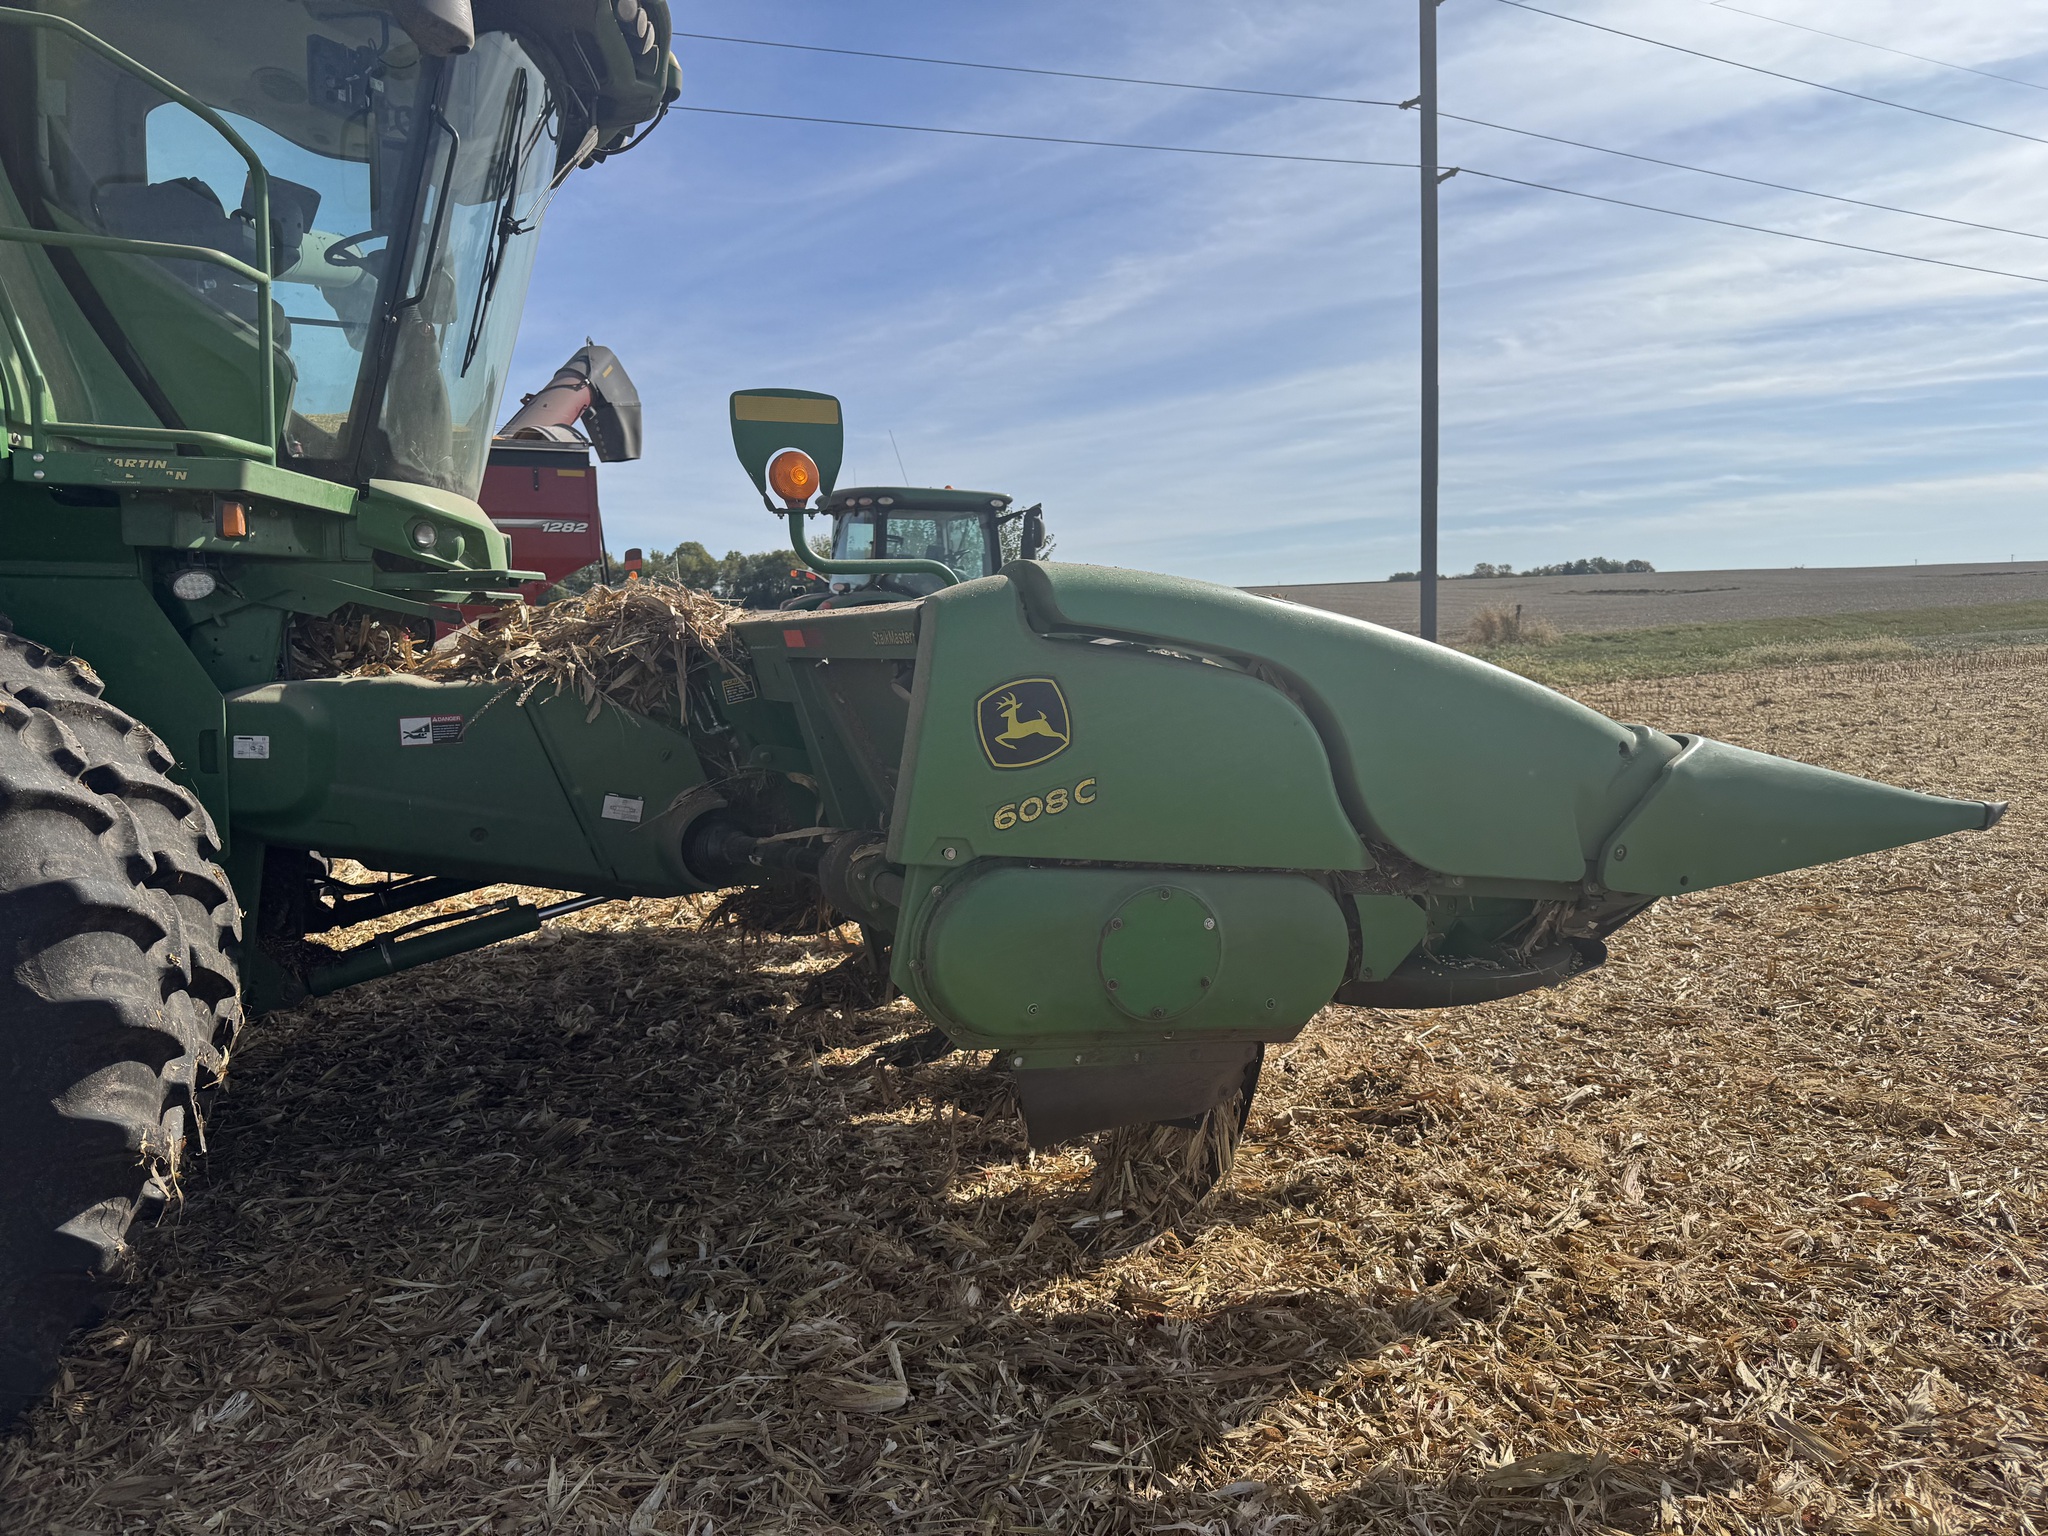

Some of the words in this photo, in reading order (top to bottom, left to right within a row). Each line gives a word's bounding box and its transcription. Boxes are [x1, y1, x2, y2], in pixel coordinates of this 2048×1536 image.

[96, 457, 168, 469] ARTIN
[542, 522, 588, 533] 1282
[993, 777, 1097, 830] 608C
